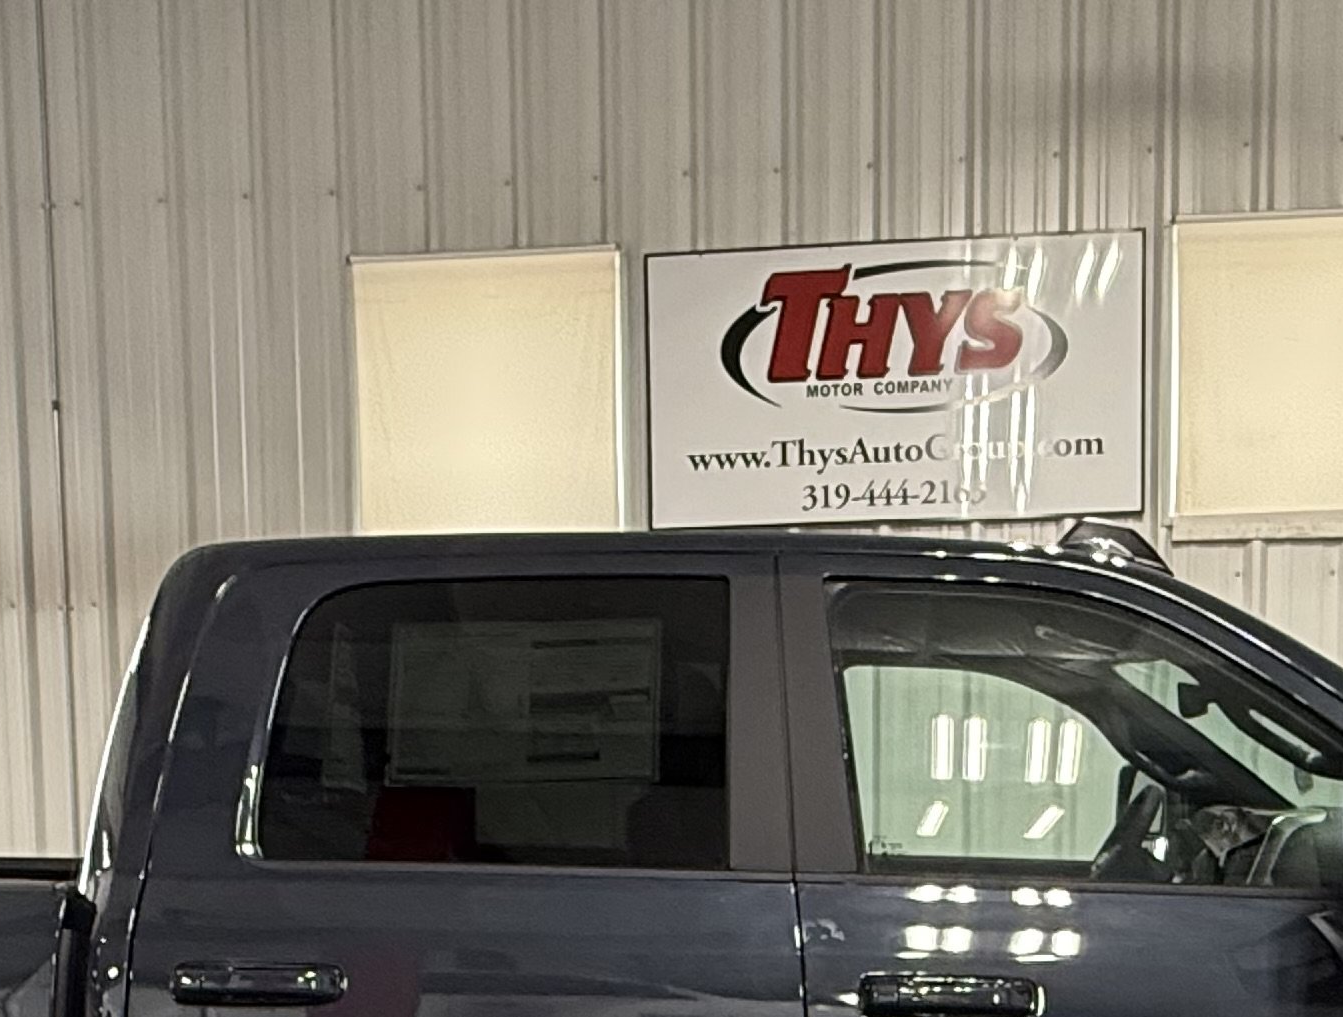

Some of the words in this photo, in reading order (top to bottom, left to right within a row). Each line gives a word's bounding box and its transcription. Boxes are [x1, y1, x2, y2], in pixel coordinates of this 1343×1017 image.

[806, 382, 864, 398] MOTOR
[873, 378, 953, 395] COMPANY
[687, 433, 1105, 475] www.ThysAutoGroupcom
